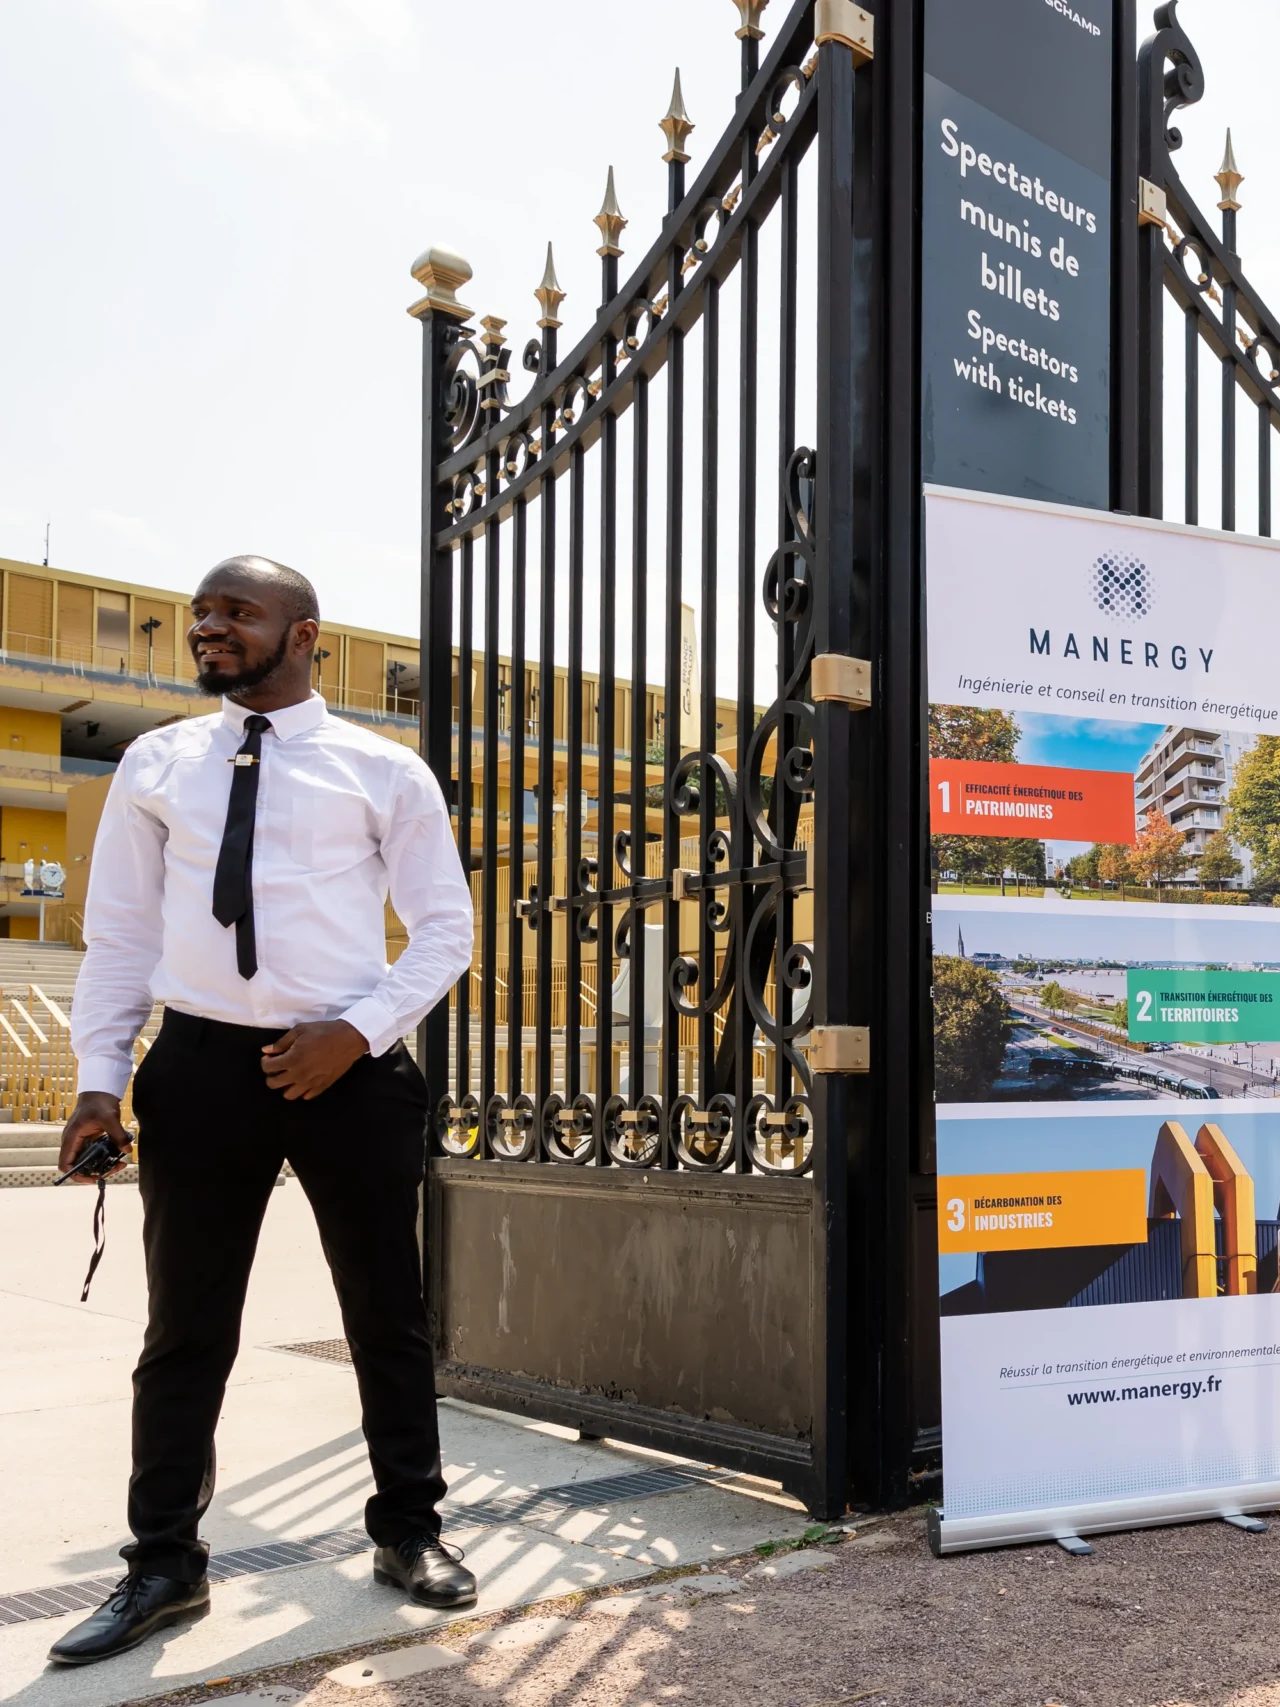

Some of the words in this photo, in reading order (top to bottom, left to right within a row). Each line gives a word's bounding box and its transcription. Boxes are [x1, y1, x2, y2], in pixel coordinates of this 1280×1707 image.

[941, 118, 1097, 234] Spectateurs
[960, 198, 1042, 259] munis
[1050, 237, 1080, 277] de
[981, 253, 1060, 322] billets
[967, 309, 1079, 384] Spectators
[953, 357, 1002, 395] with
[1008, 378, 1077, 425] tickets
[1029, 627, 1214, 673] MANERGY
[958, 674, 1034, 695] Ingénierie
[1038, 684, 1053, 697] et
[1056, 688, 1105, 703] conseil
[1109, 693, 1126, 705] en
[1131, 692, 1198, 712] transition
[1201, 698, 1279, 722] énergétique
[938, 781, 950, 813] 1
[965, 783, 1011, 796] EFFICACITÉ
[1013, 784, 1067, 800] ÉNERGÉTIQUE
[1068, 791, 1084, 801] DES
[965, 799, 1053, 820] PATRIMOINES
[1136, 990, 1152, 1022] 2
[1160, 992, 1206, 1002] TRANSITION
[1208, 990, 1258, 1003] ÉNERGÉTIQUE
[1259, 993, 1273, 1003] DES
[1160, 1007, 1239, 1023] TERRITOIRES
[946, 1198, 966, 1232] 3
[974, 1196, 1044, 1209] DÉCARBONATION
[1046, 1195, 1062, 1206] DES
[974, 1212, 1053, 1231] INDUSTRIES
[999, 1364, 1039, 1379] Réussir
[1042, 1363, 1053, 1375] la
[1056, 1359, 1108, 1374] transition
[1111, 1354, 1173, 1370] énergétique
[1176, 1352, 1186, 1363] et
[1067, 1375, 1222, 1406] www.manergy.fr
